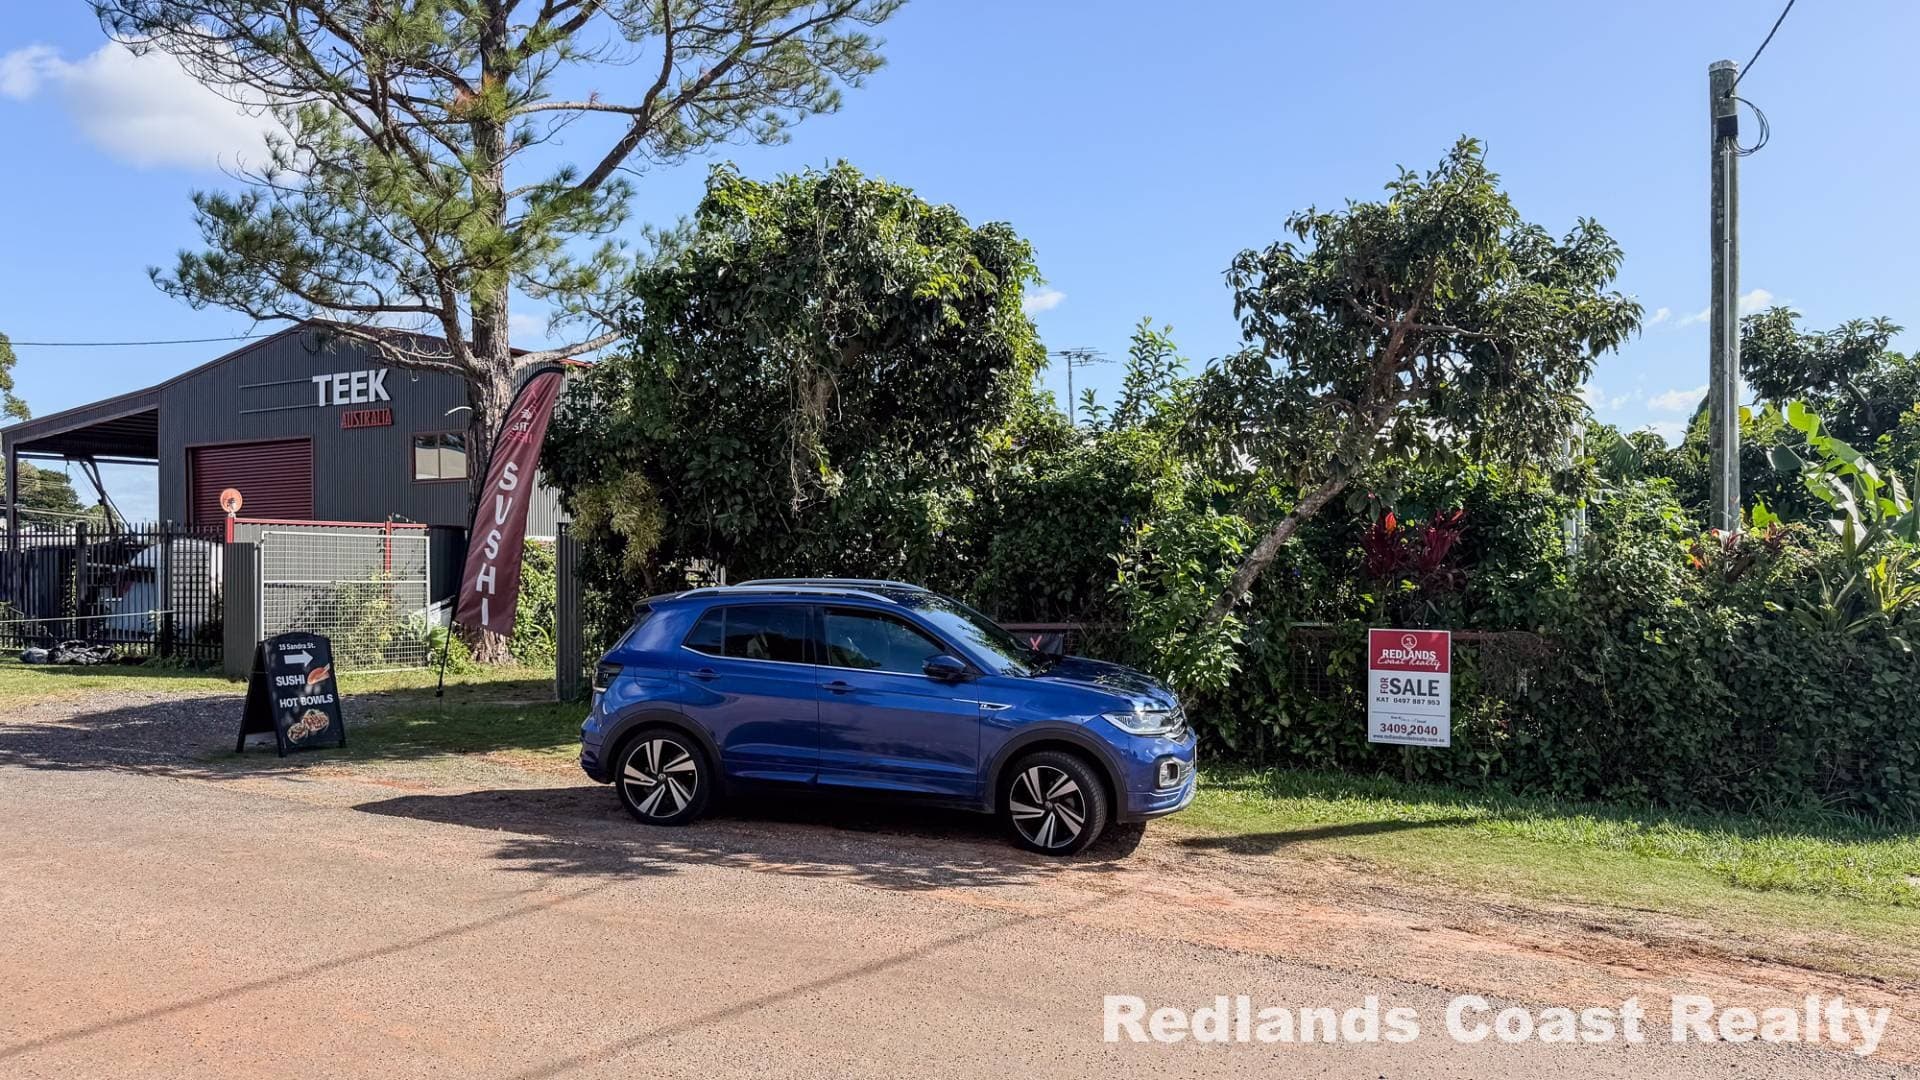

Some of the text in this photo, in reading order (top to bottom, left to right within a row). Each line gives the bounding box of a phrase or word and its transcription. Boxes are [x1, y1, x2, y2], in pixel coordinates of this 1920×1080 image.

[312, 368, 391, 407] TEEK
[341, 408, 393, 430] AUSTRALIA
[475, 461, 519, 626] SUSHI
[1382, 648, 1437, 661] REDLANDS
[1409, 658, 1441, 671] Realty
[275, 674, 305, 687] SUSHI
[1380, 677, 1440, 697] FOR SALE
[280, 694, 334, 708] HOT BOWLS
